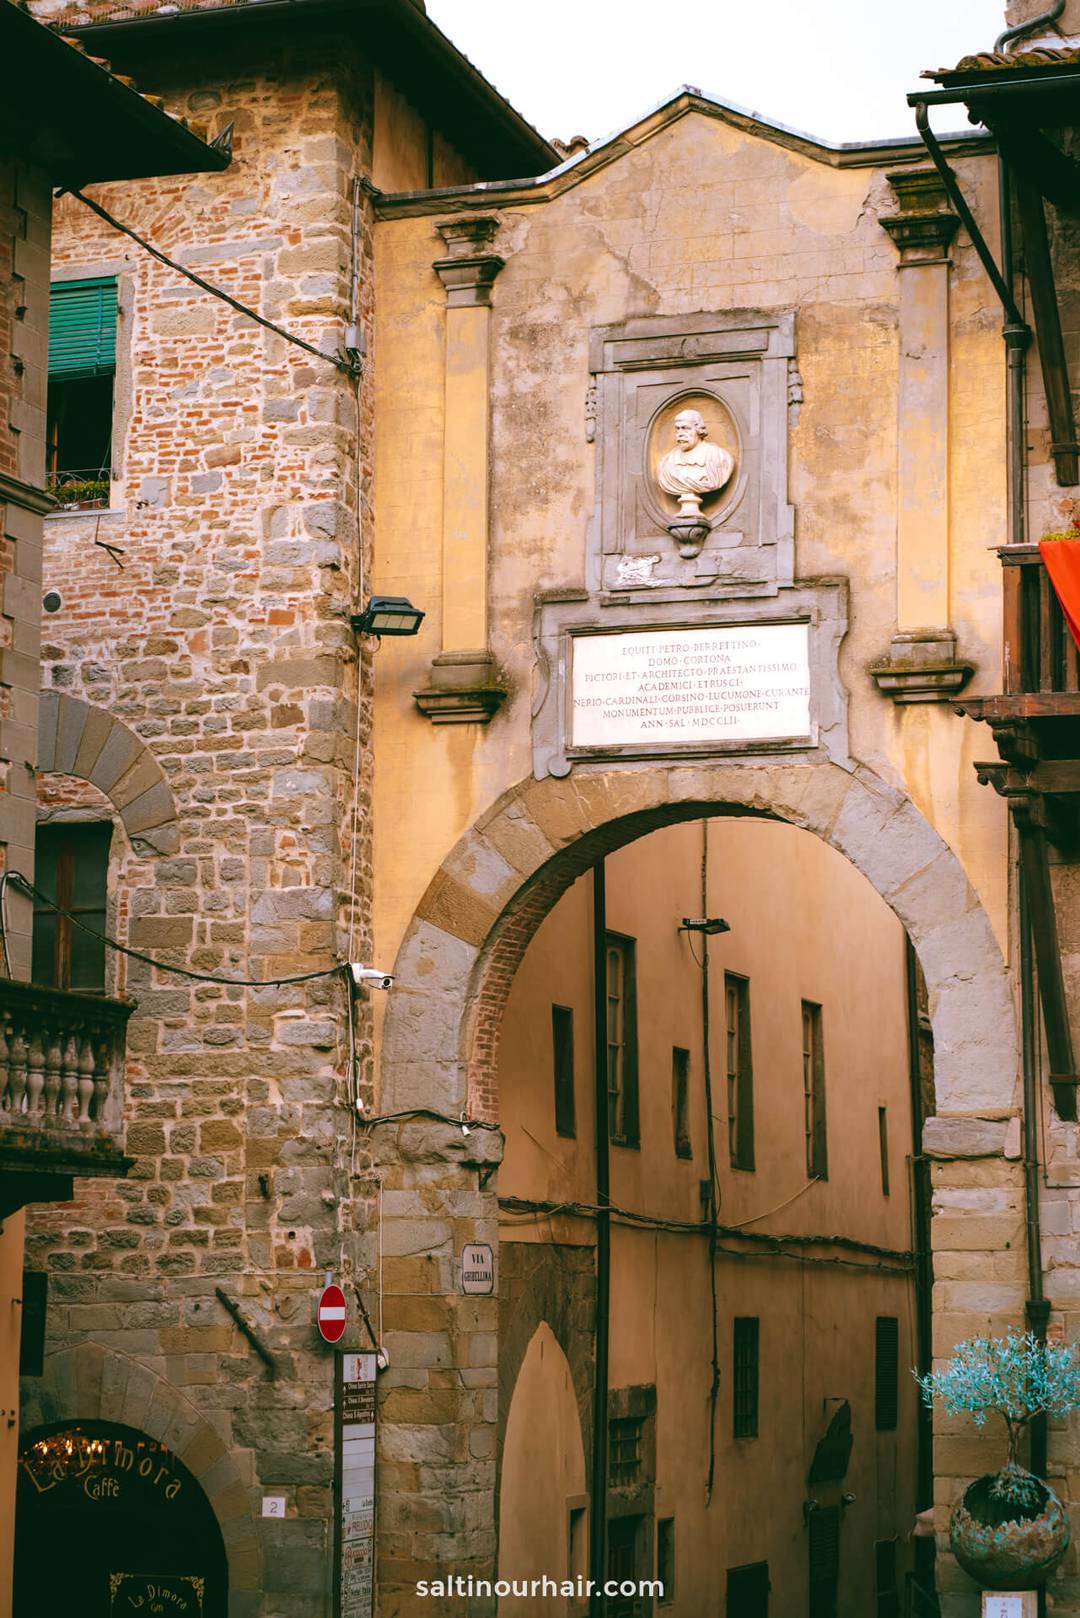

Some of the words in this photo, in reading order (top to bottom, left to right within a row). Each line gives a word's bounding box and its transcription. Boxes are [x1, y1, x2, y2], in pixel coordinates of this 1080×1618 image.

[659, 644, 689, 653] PETRO
[648, 657, 678, 667] DOMO
[684, 654, 731, 665] CORTONA
[626, 671, 637, 680] ET
[642, 668, 703, 680] ARCHITECTO
[708, 663, 797, 676] PRAESTANTISSIMO
[638, 680, 692, 692] ACADEMICI
[698, 678, 739, 689] ETRUSCI
[606, 695, 658, 706] CARDINALI
[662, 692, 705, 703] CORSINO
[709, 690, 761, 701] LUCUMONE
[765, 688, 810, 698] CURANTE
[603, 707, 673, 719] MONUMENTUM
[677, 704, 720, 715] PUBBLICE
[724, 701, 779, 713] POSUERUNT
[640, 720, 663, 729] ANN
[669, 718, 686, 728] SAL
[471, 1253, 485, 1264] VIA
[23, 1459, 65, 1493] La
[75, 1441, 182, 1500] Dimora
[84, 1475, 120, 1500] Caffè
[147, 1584, 187, 1610] Dimora
